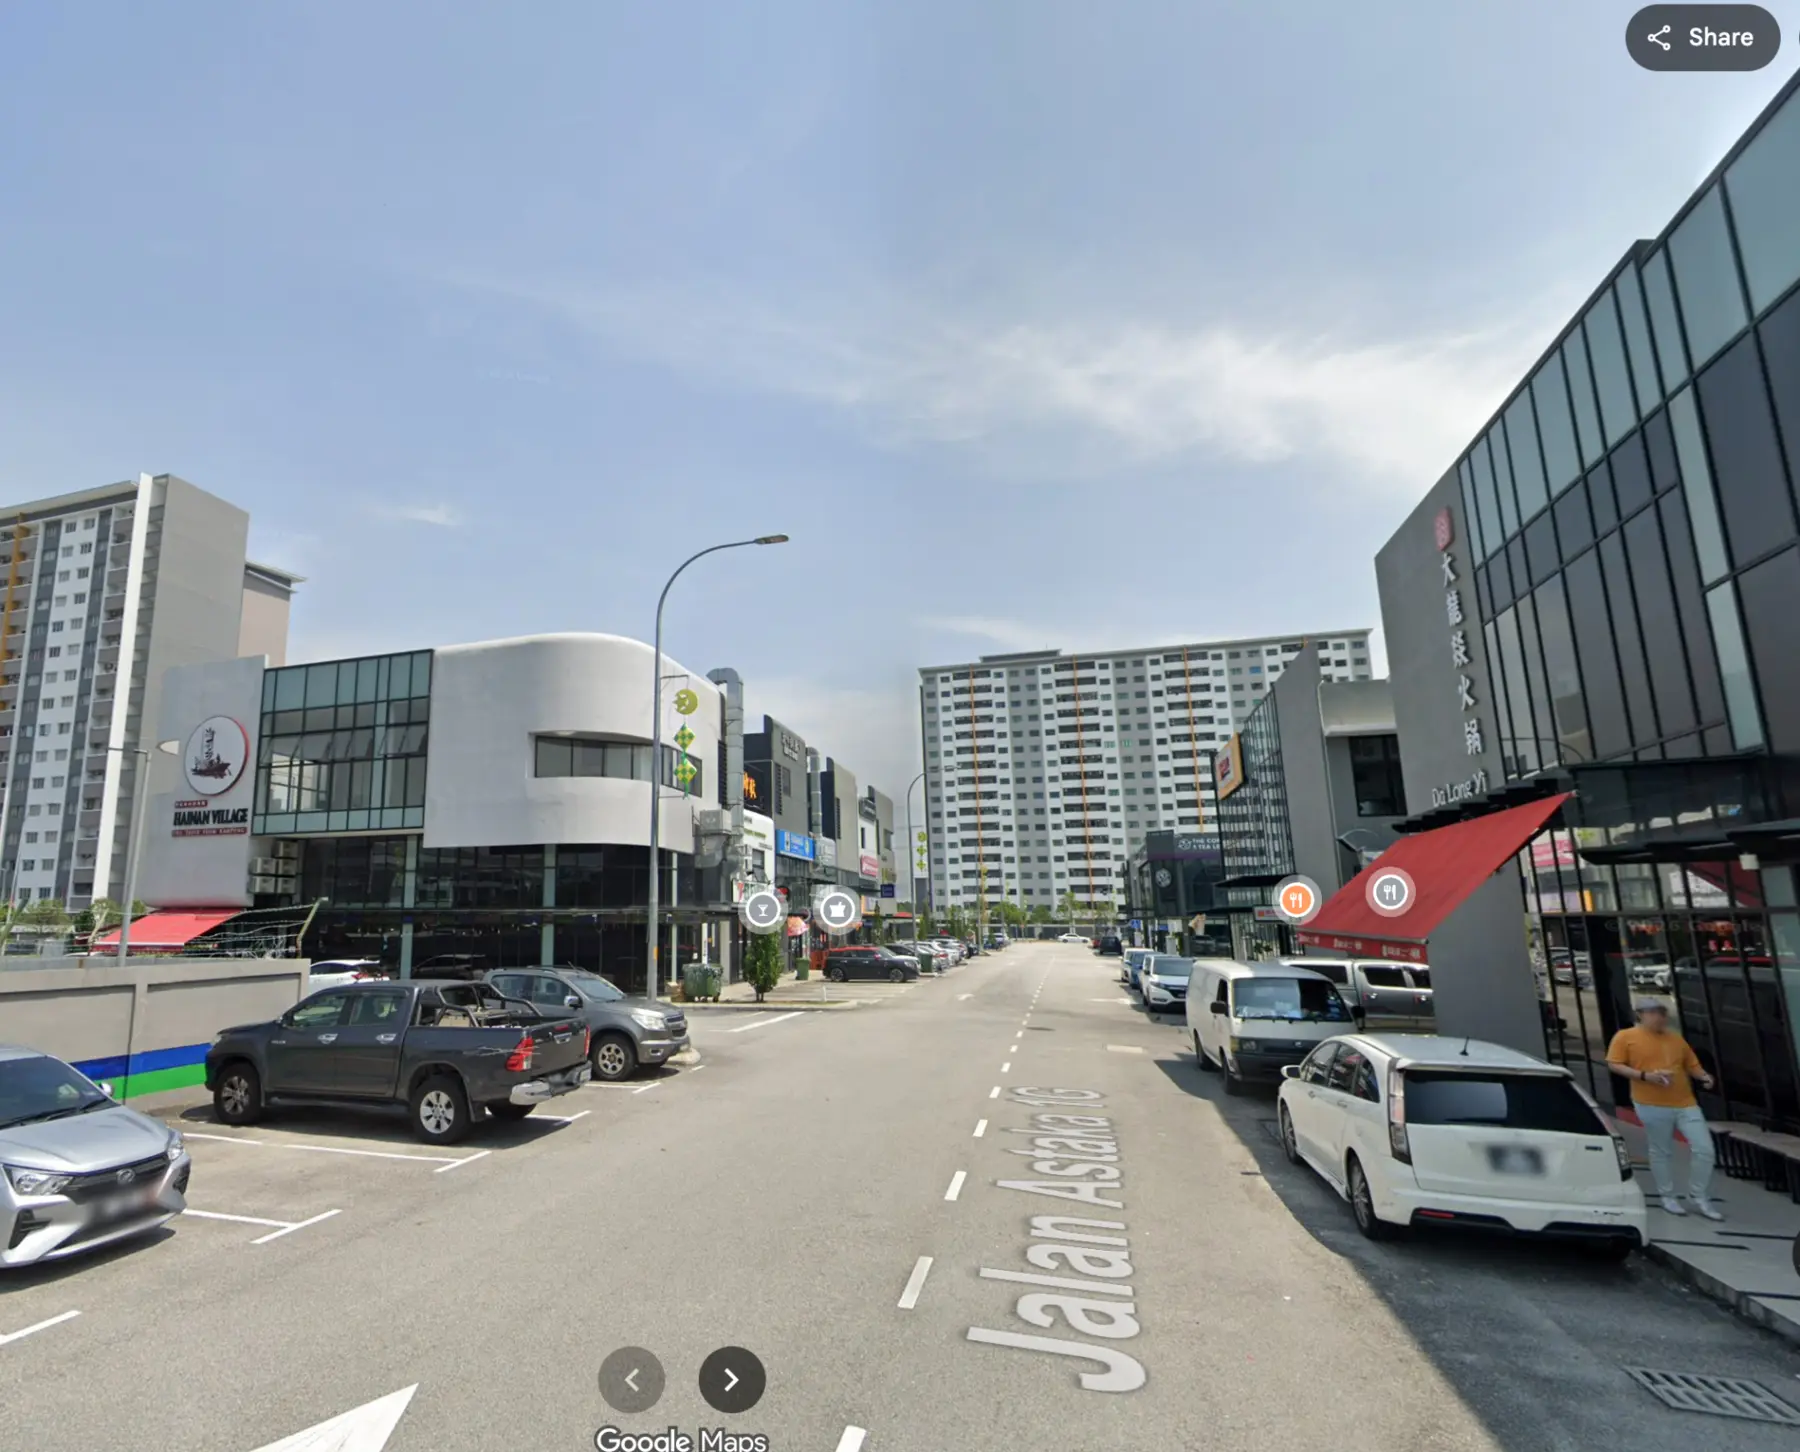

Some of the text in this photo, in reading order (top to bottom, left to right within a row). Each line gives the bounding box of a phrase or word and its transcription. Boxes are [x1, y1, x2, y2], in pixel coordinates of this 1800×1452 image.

[1431, 767, 1487, 808] Da Long Yi
[173, 808, 249, 826] HAINAN VILLAGE
